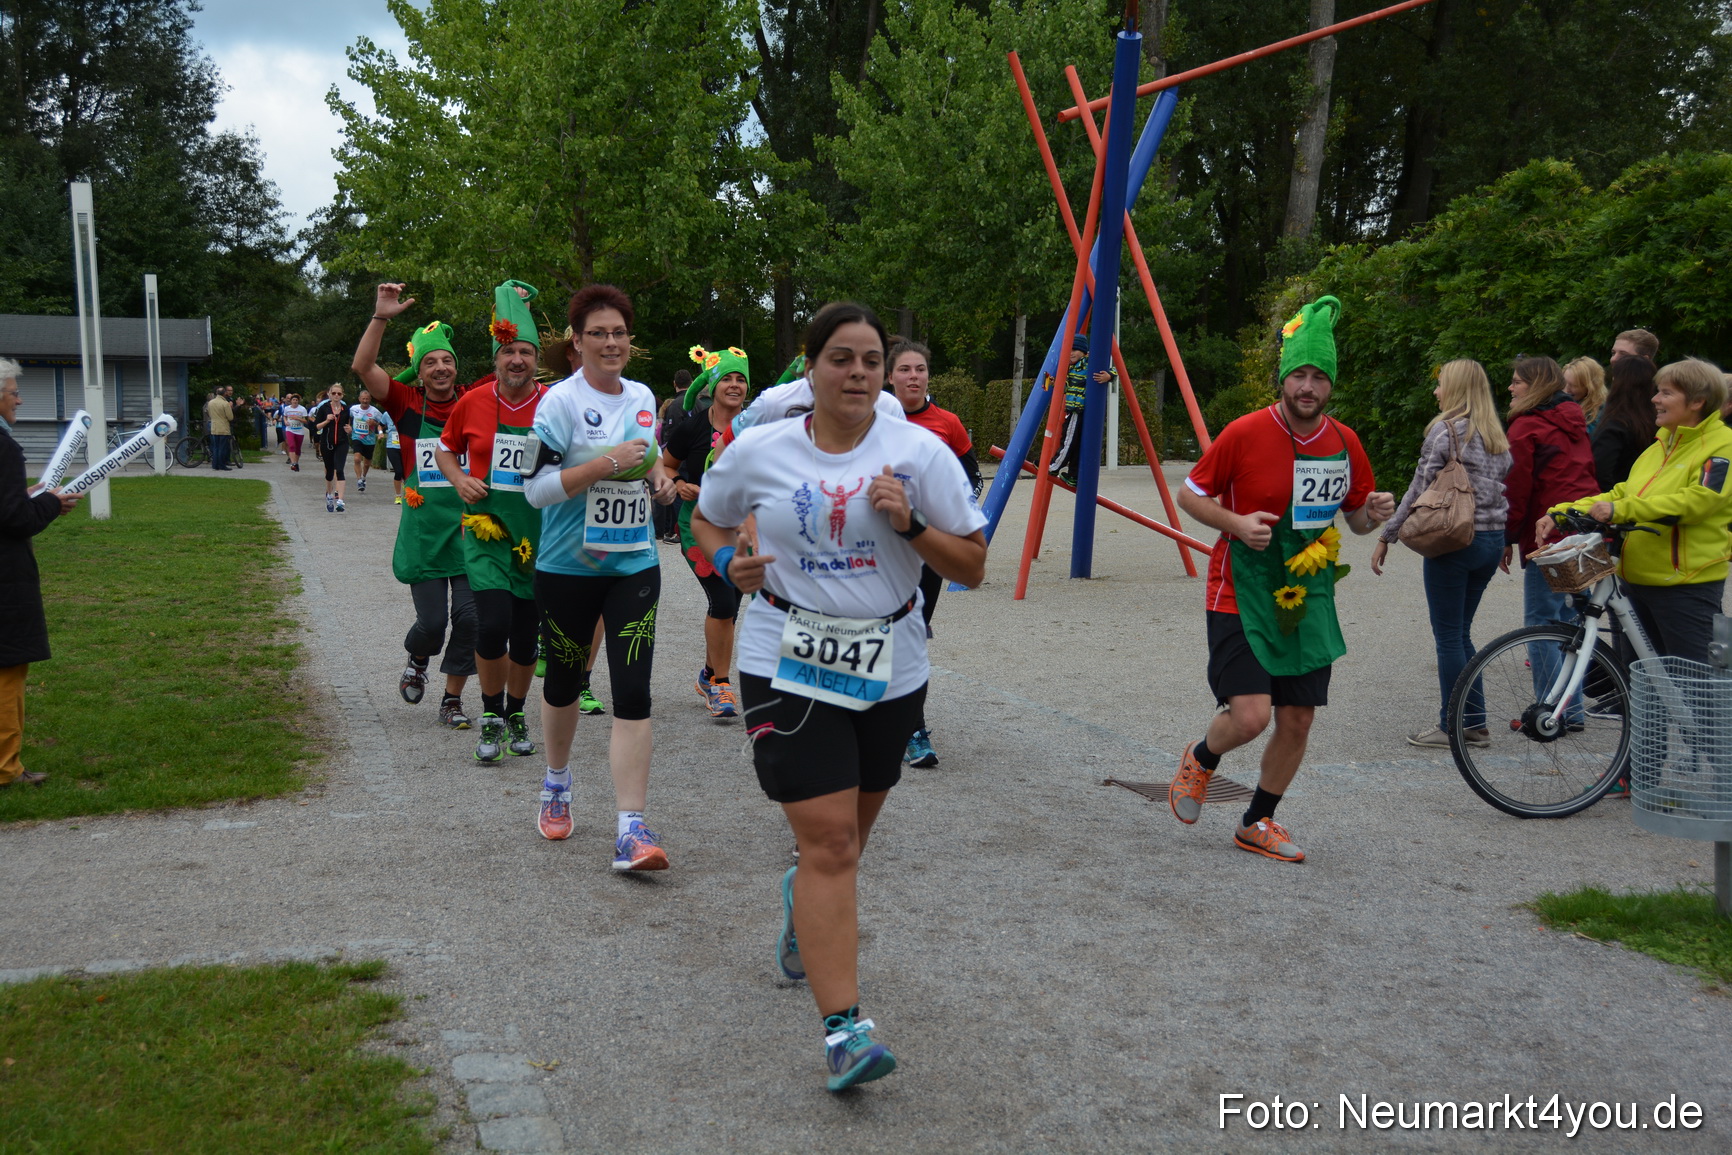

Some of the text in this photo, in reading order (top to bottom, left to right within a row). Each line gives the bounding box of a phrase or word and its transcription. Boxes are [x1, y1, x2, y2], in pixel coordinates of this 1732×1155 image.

[495, 438, 517, 447] PARTL
[499, 447, 524, 470] 20
[1295, 467, 1322, 475] PARTL
[589, 486, 616, 495] PARTL
[1302, 474, 1347, 502] 2423
[594, 497, 646, 525] 3019
[599, 529, 640, 542] ALEX
[789, 614, 876, 637] PARTL Neumarkt
[792, 631, 885, 674] 3047
[793, 663, 869, 701] ANGELA
